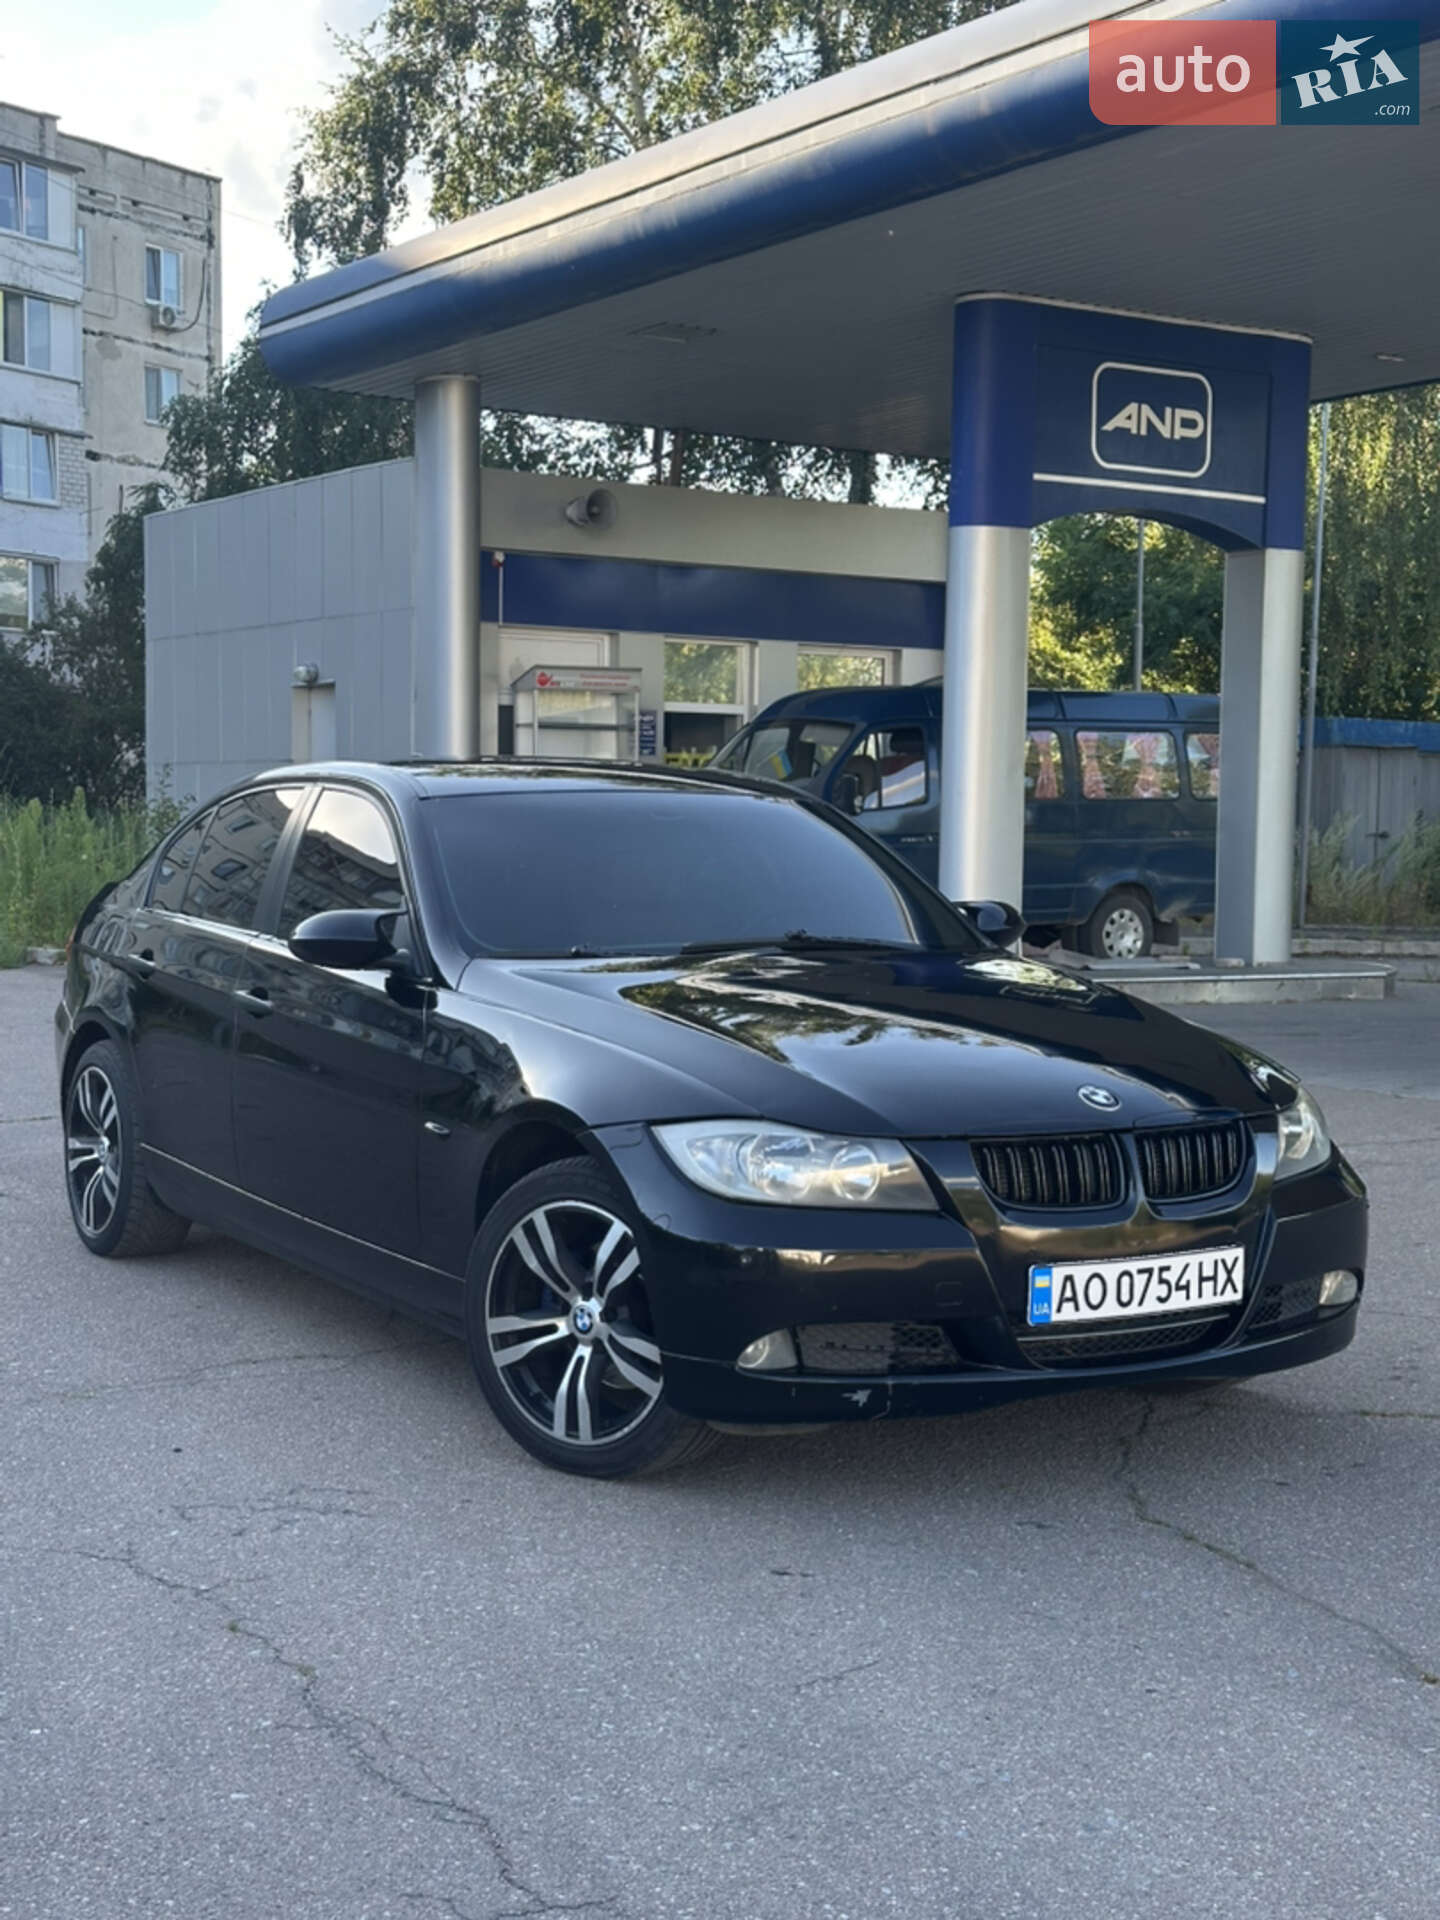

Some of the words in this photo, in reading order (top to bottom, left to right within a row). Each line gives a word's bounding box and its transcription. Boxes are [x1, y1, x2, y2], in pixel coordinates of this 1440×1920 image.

[1101, 402, 1204, 440] ANP
[1116, 1263, 1191, 1308] 0754
[1033, 1303, 1050, 1315] UA
